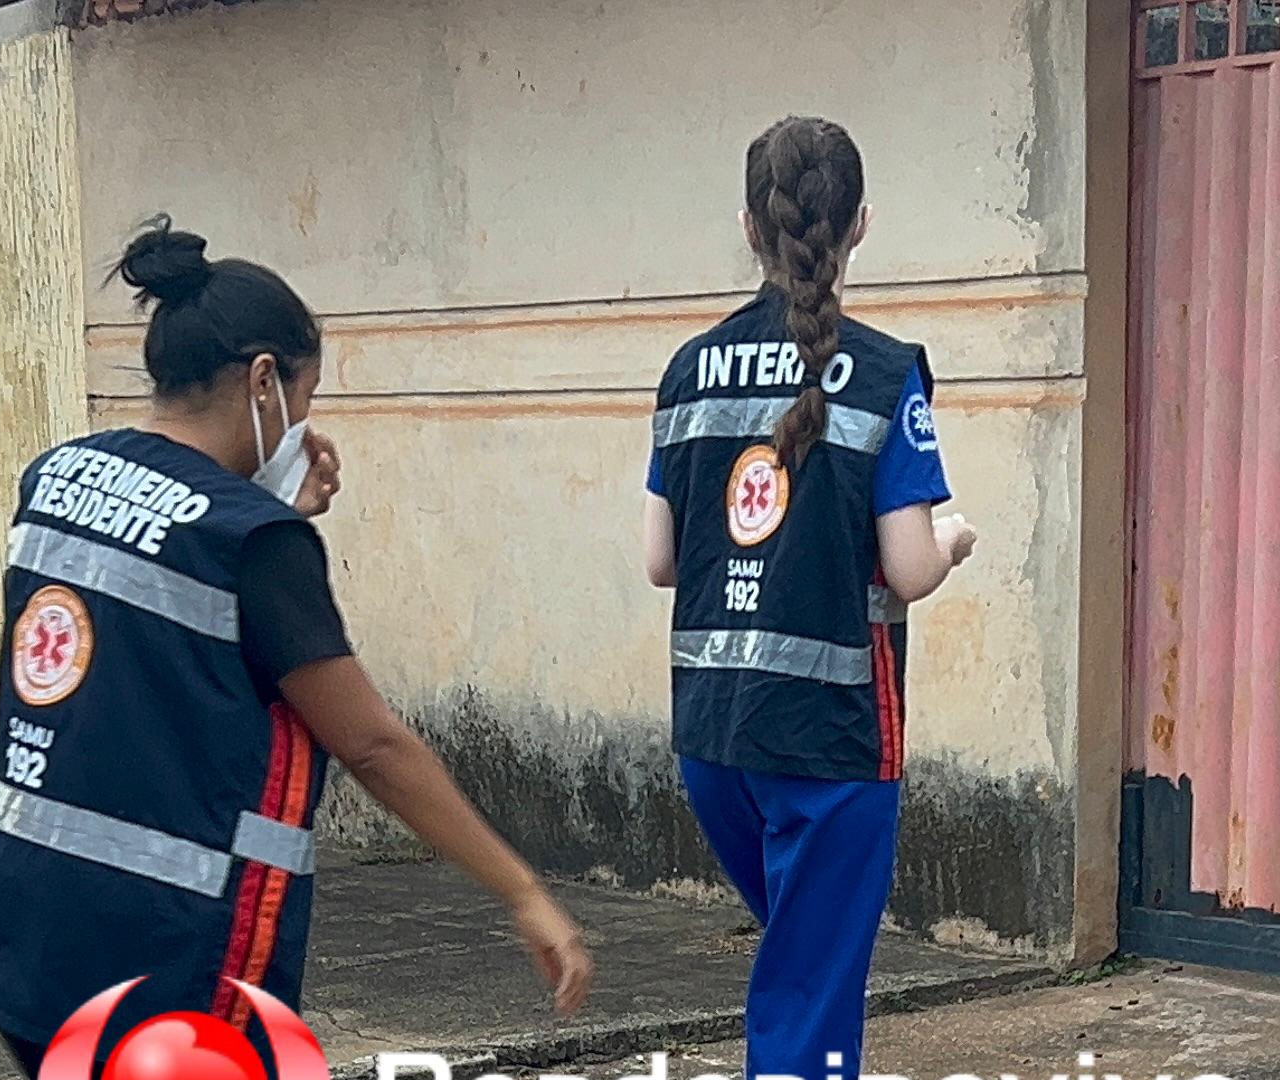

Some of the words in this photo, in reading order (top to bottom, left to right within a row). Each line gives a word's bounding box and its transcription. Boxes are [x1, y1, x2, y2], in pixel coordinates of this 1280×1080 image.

[696, 341, 855, 395] INTERO
[38, 446, 211, 524] ENFERMEIRO
[27, 475, 172, 555] RESIDENTE
[727, 558, 764, 580] SAMU
[724, 581, 760, 613] 192
[8, 716, 56, 749] SAMU
[6, 742, 48, 789] 192
